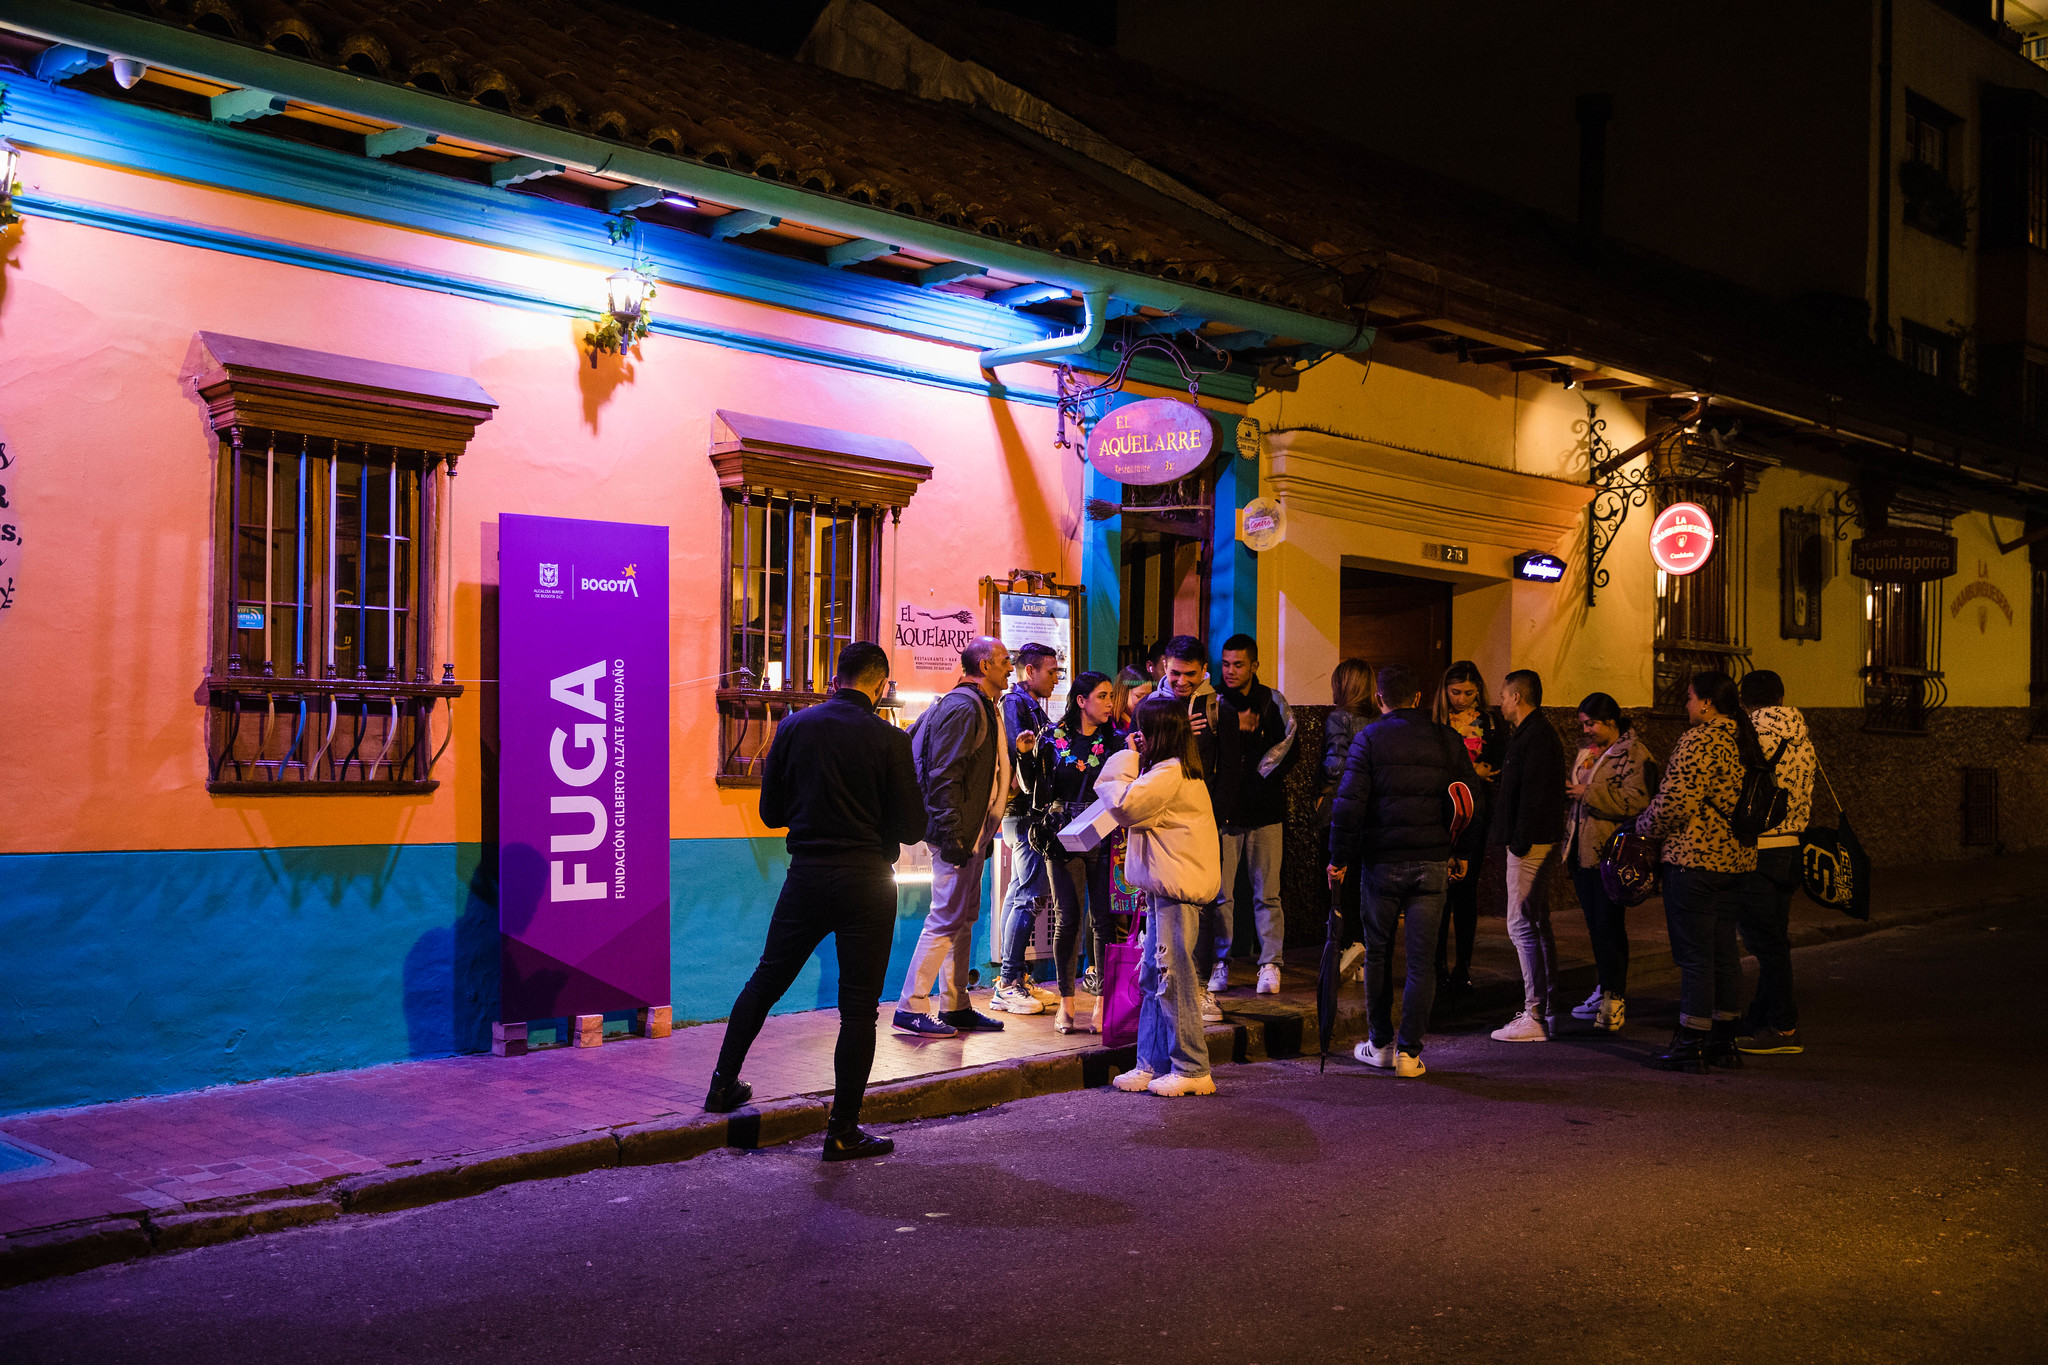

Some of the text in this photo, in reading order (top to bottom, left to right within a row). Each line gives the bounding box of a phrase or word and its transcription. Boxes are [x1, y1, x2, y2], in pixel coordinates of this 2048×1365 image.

[1116, 415, 1131, 429] EL
[1099, 429, 1201, 457] AQUELARRE
[1675, 516, 1687, 525] LA
[1853, 553, 1950, 575] laquintaporra
[901, 605, 915, 623] EL
[550, 660, 608, 902] FUGA
[612, 659, 626, 900] FUNDACIÓN GILBERTO ALZATE AVENDAÑO
[1110, 893, 1130, 911] Feliz
